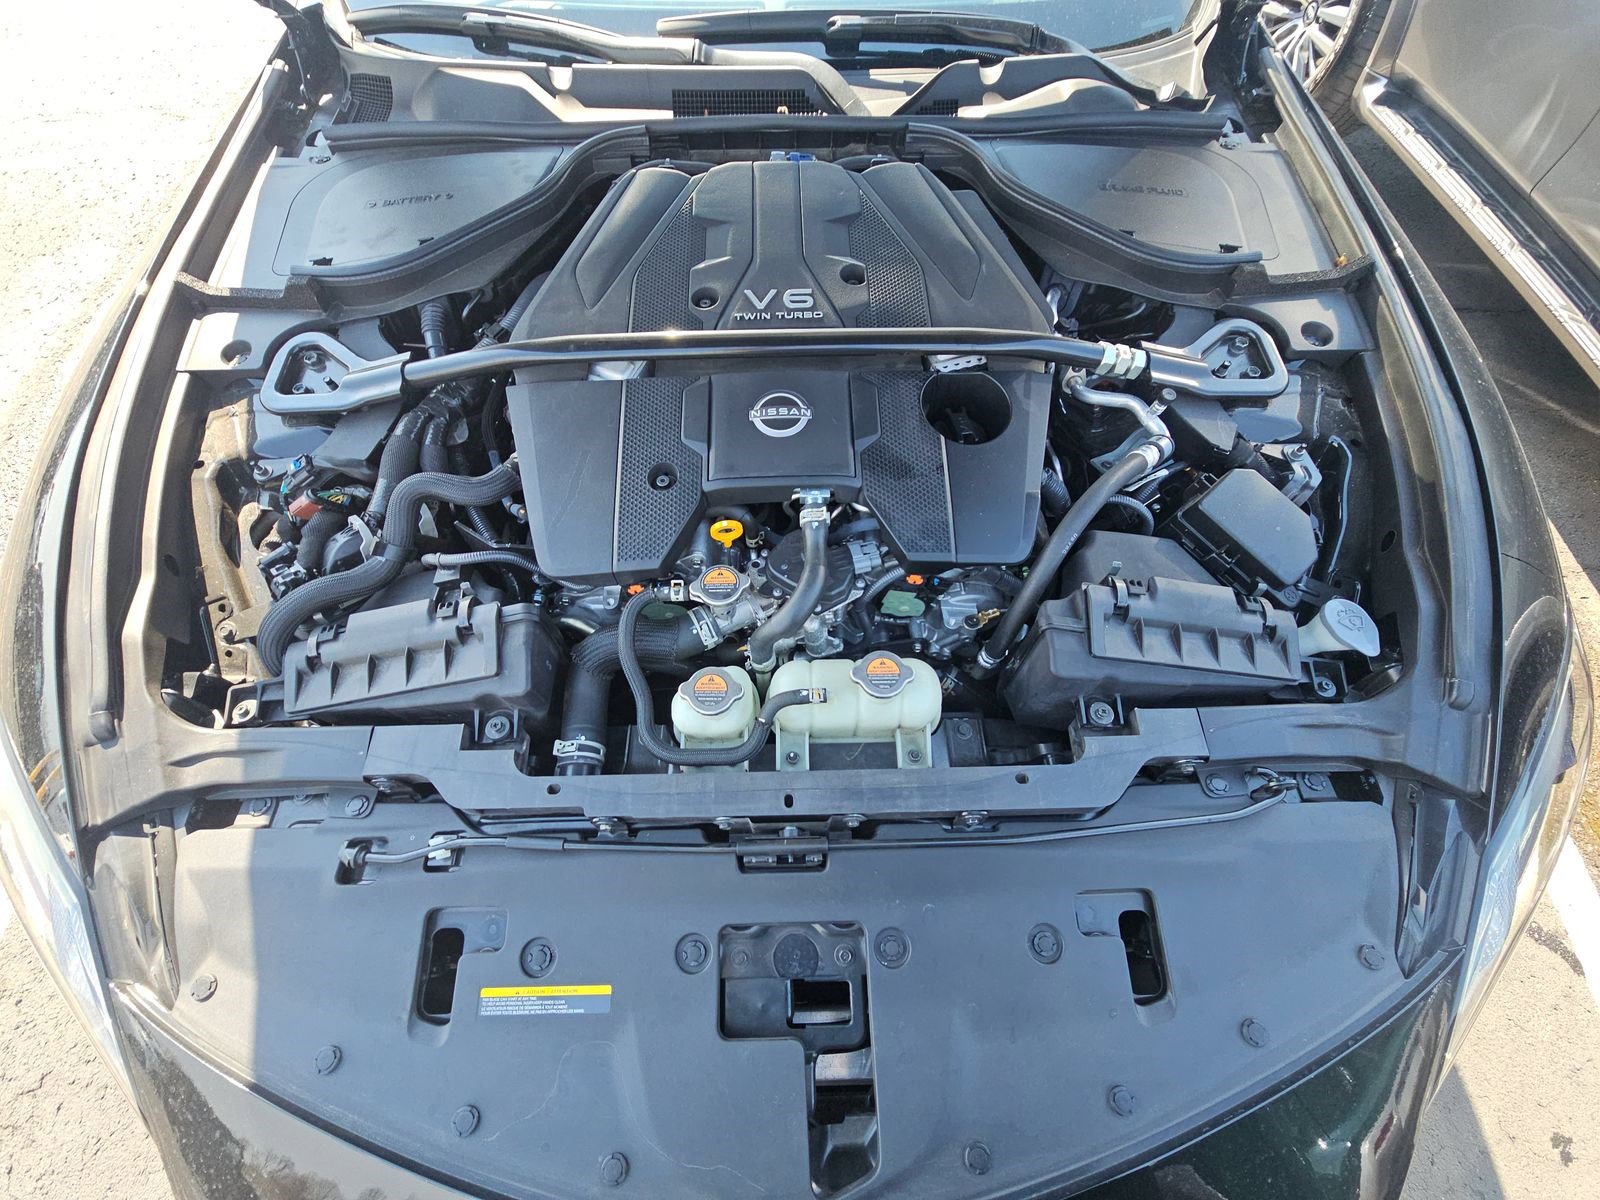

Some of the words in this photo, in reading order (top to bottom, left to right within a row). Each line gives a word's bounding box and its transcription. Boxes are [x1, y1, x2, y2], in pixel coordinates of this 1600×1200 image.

[743, 287, 815, 310] V6
[734, 311, 771, 321] TWIN
[775, 310, 824, 320] TURBO
[750, 407, 811, 418] NISSAN
